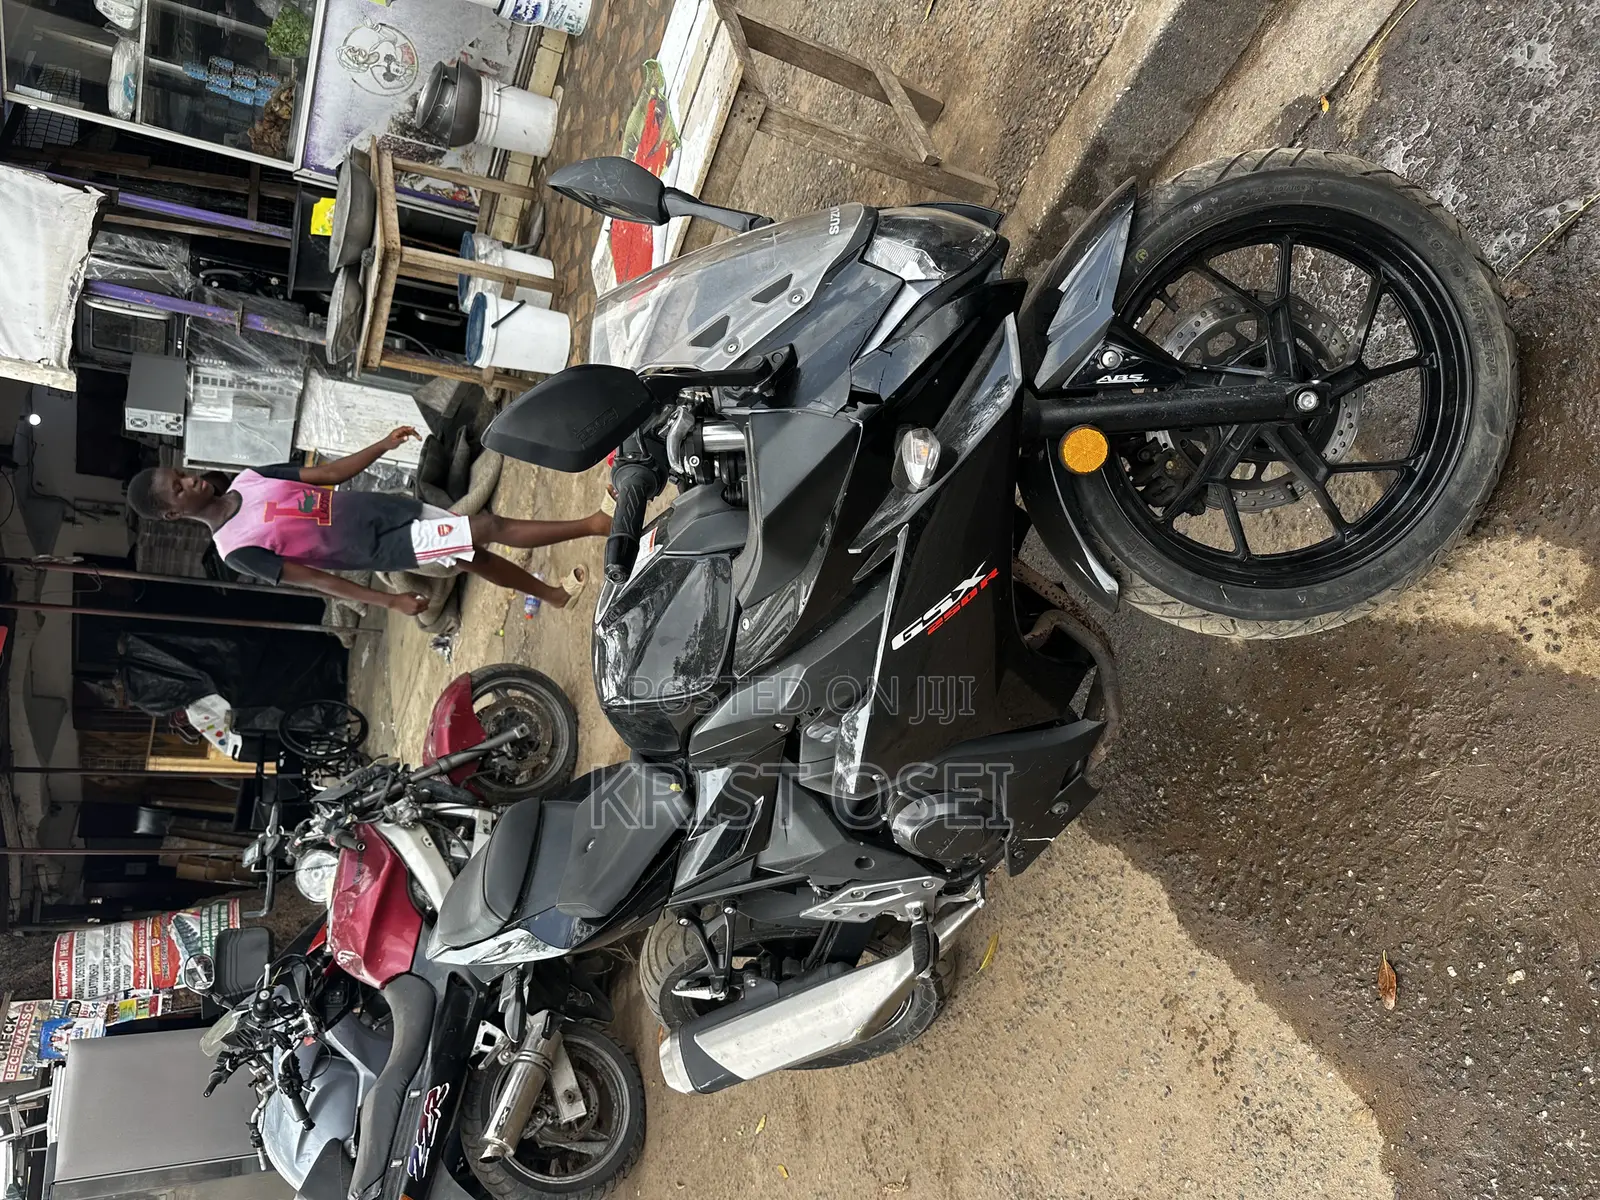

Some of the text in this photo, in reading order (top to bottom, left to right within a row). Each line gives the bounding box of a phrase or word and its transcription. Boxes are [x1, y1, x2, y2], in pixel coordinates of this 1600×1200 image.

[1095, 373, 1145, 385] ABS
[891, 560, 987, 651] GSX
[926, 567, 1000, 636] 250R
[58, 959, 69, 985] VACANCY
[0, 1016, 19, 1061] CHECK
[4, 1002, 36, 1080] BECE/WASSC
